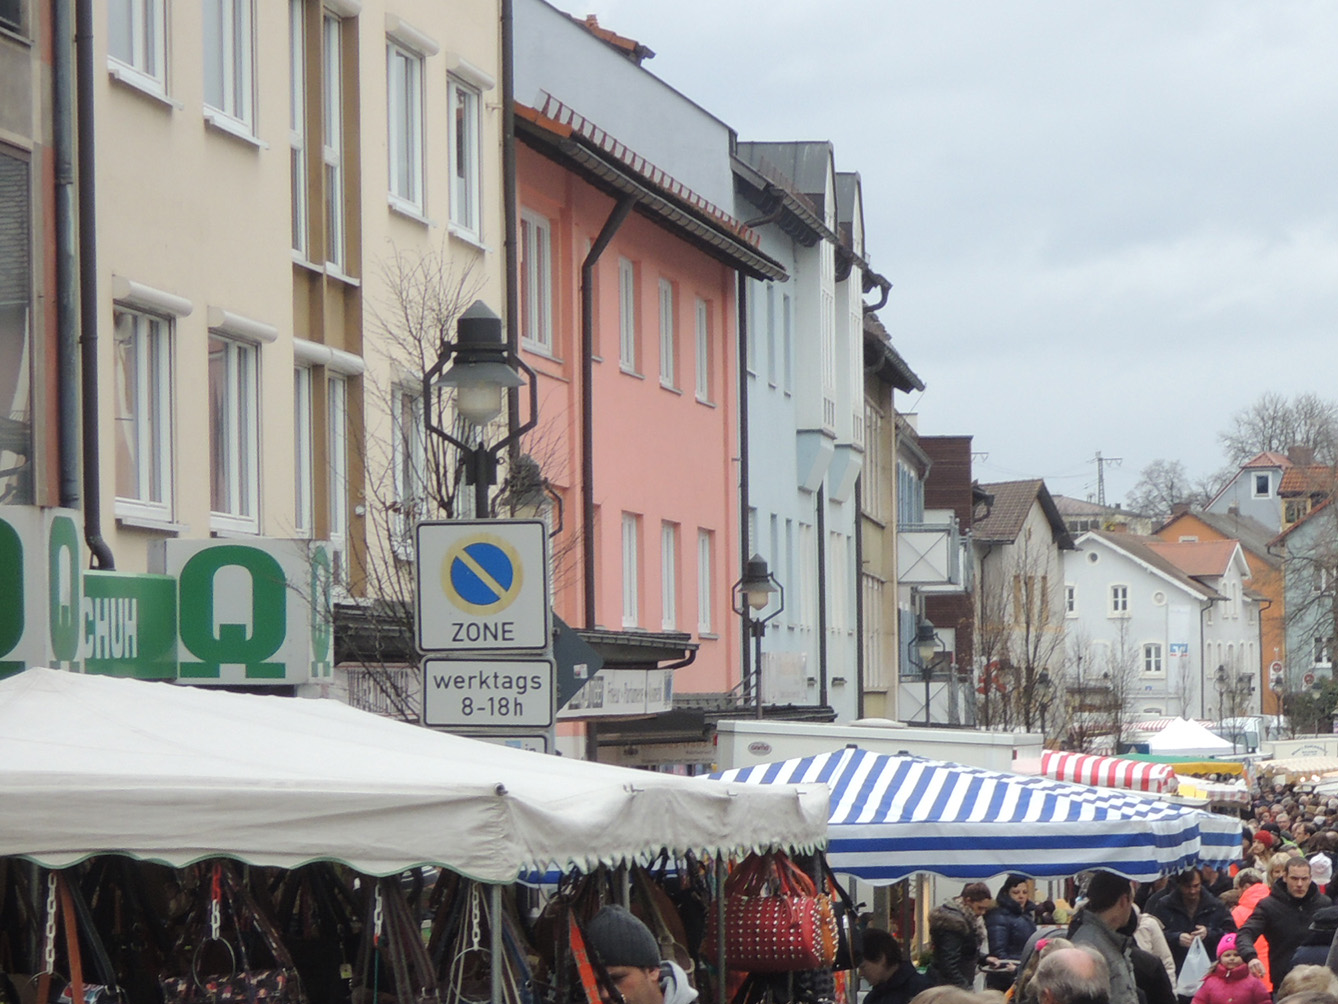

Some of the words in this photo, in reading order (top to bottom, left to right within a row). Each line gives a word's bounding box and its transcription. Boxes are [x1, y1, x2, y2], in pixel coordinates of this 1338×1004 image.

[452, 622, 514, 641] ZONE
[433, 670, 542, 695] werktags
[461, 697, 523, 716] 8-18h
